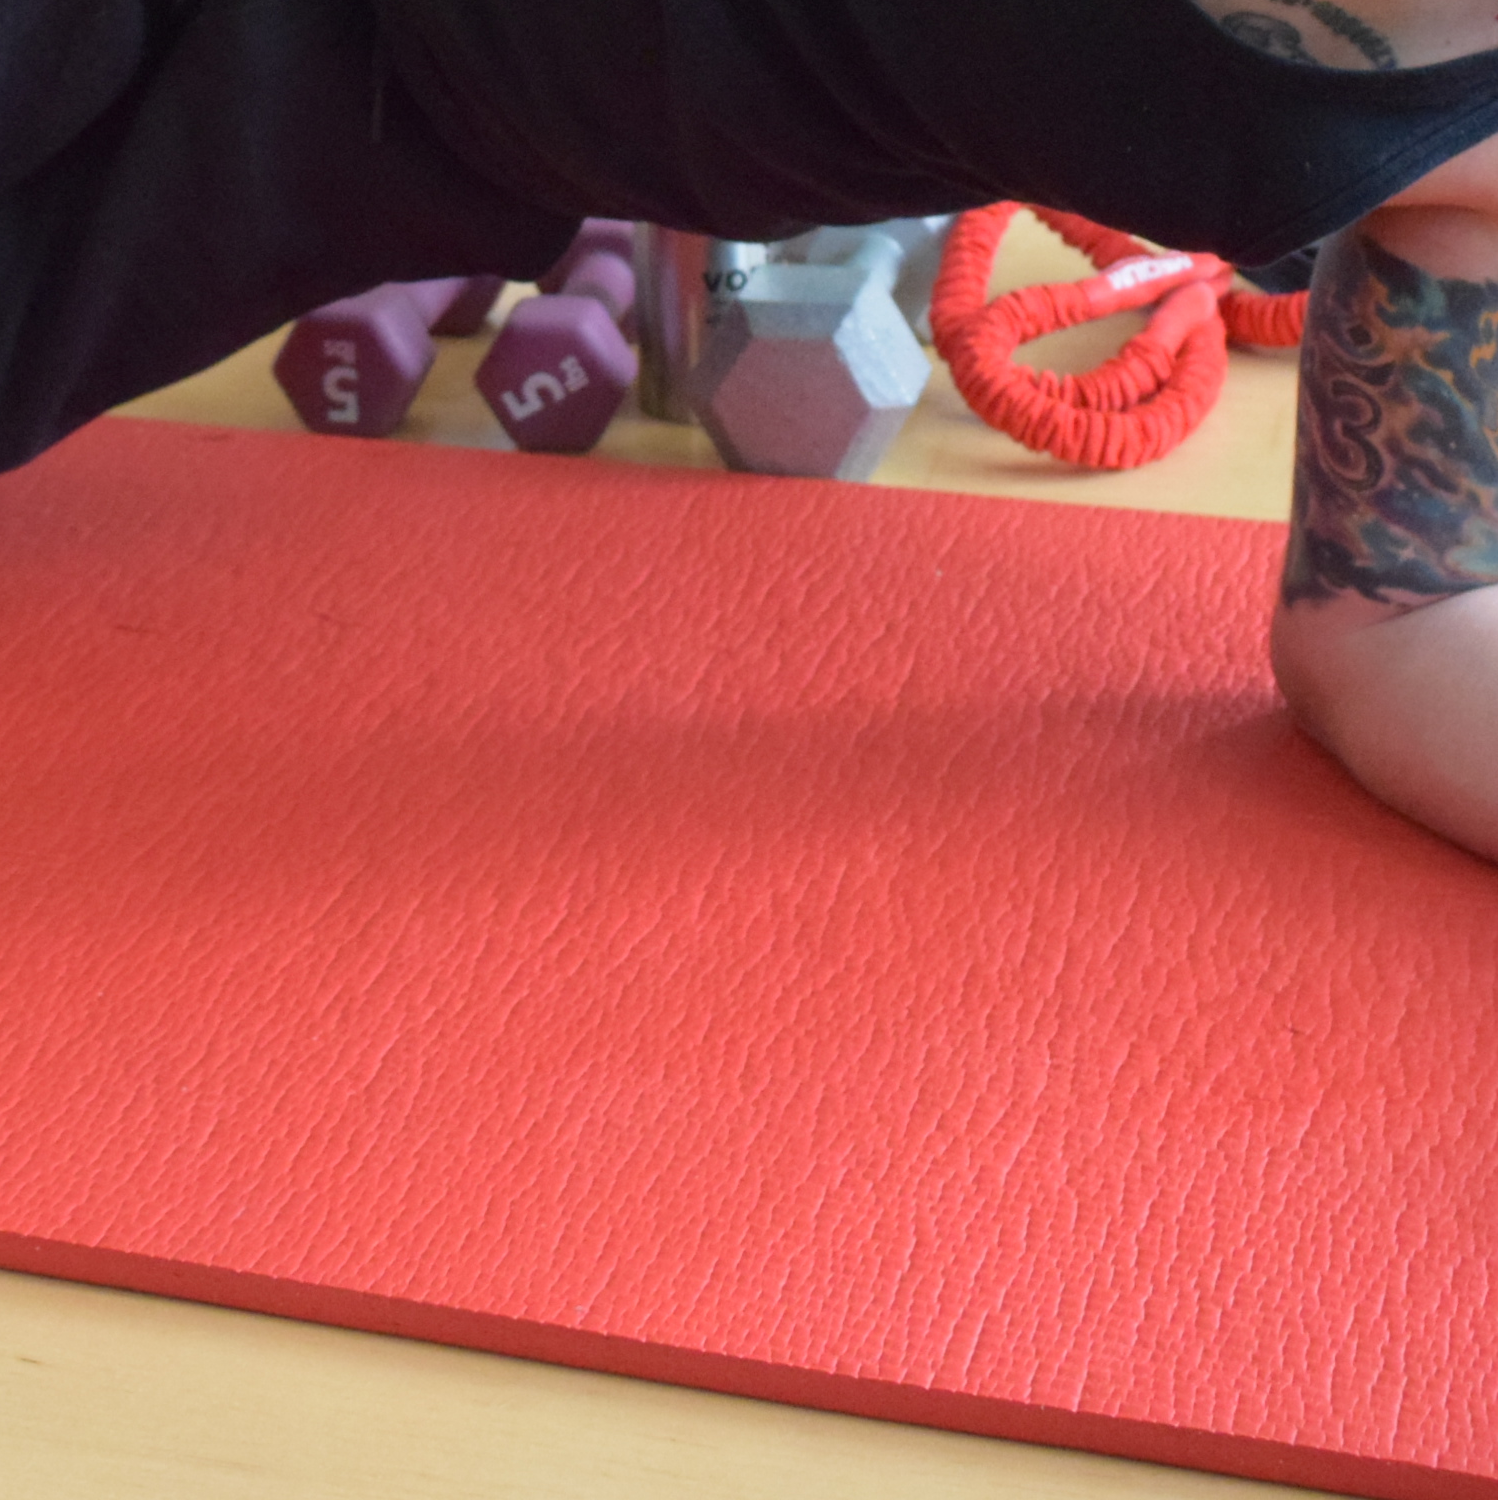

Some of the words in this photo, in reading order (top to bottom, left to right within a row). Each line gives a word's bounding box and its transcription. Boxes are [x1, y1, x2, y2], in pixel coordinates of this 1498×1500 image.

[704, 266, 757, 293] VO
[322, 366, 360, 424] 5
[502, 370, 566, 422] 5
